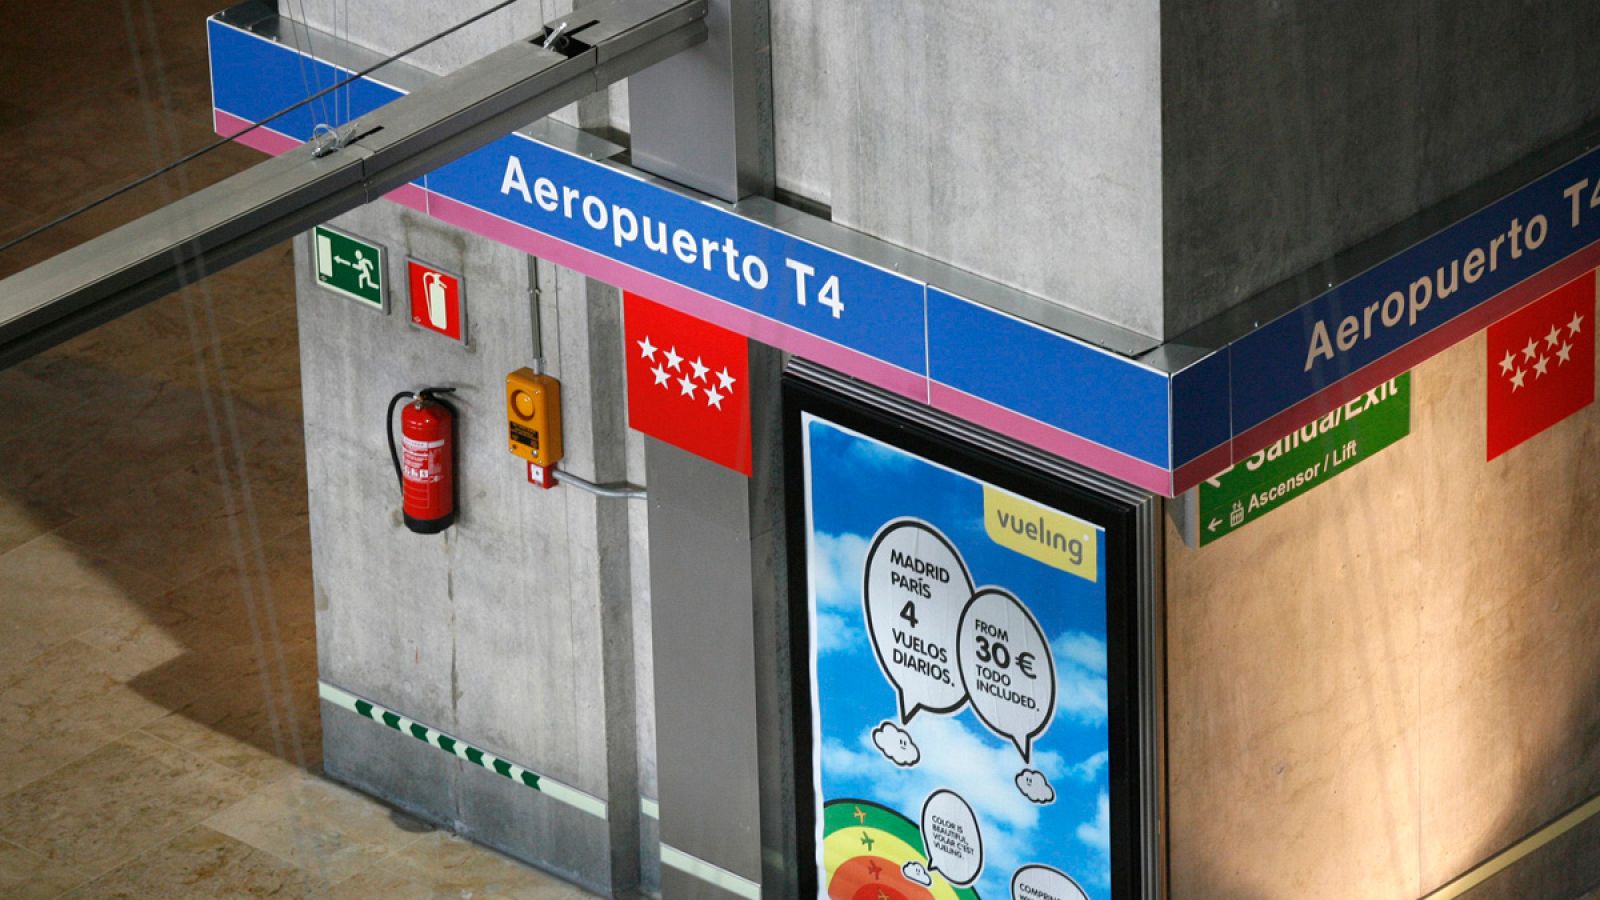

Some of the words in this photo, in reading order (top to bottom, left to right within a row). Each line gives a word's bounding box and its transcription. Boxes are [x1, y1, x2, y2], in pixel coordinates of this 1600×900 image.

[500, 155, 769, 290] Aeropuerto
[785, 257, 845, 319] T4
[1304, 214, 1548, 372] Aeropuerto
[1248, 463, 1320, 512] Ascensor
[1333, 440, 1357, 466] Lift
[997, 509, 1083, 565] vueling
[890, 549, 950, 584] MADRID
[891, 571, 931, 599] PARÍS
[900, 600, 919, 628] 4
[975, 619, 1009, 642] FROM
[892, 627, 948, 664] VUELOS
[975, 636, 1010, 669] 30
[1015, 652, 1037, 679] €
[892, 648, 955, 687] DIARIOS.
[976, 664, 1011, 686] TODO
[976, 679, 1040, 712] INCLUDED.
[932, 815, 955, 829] COLOR
[933, 832, 956, 846] VOLAR
